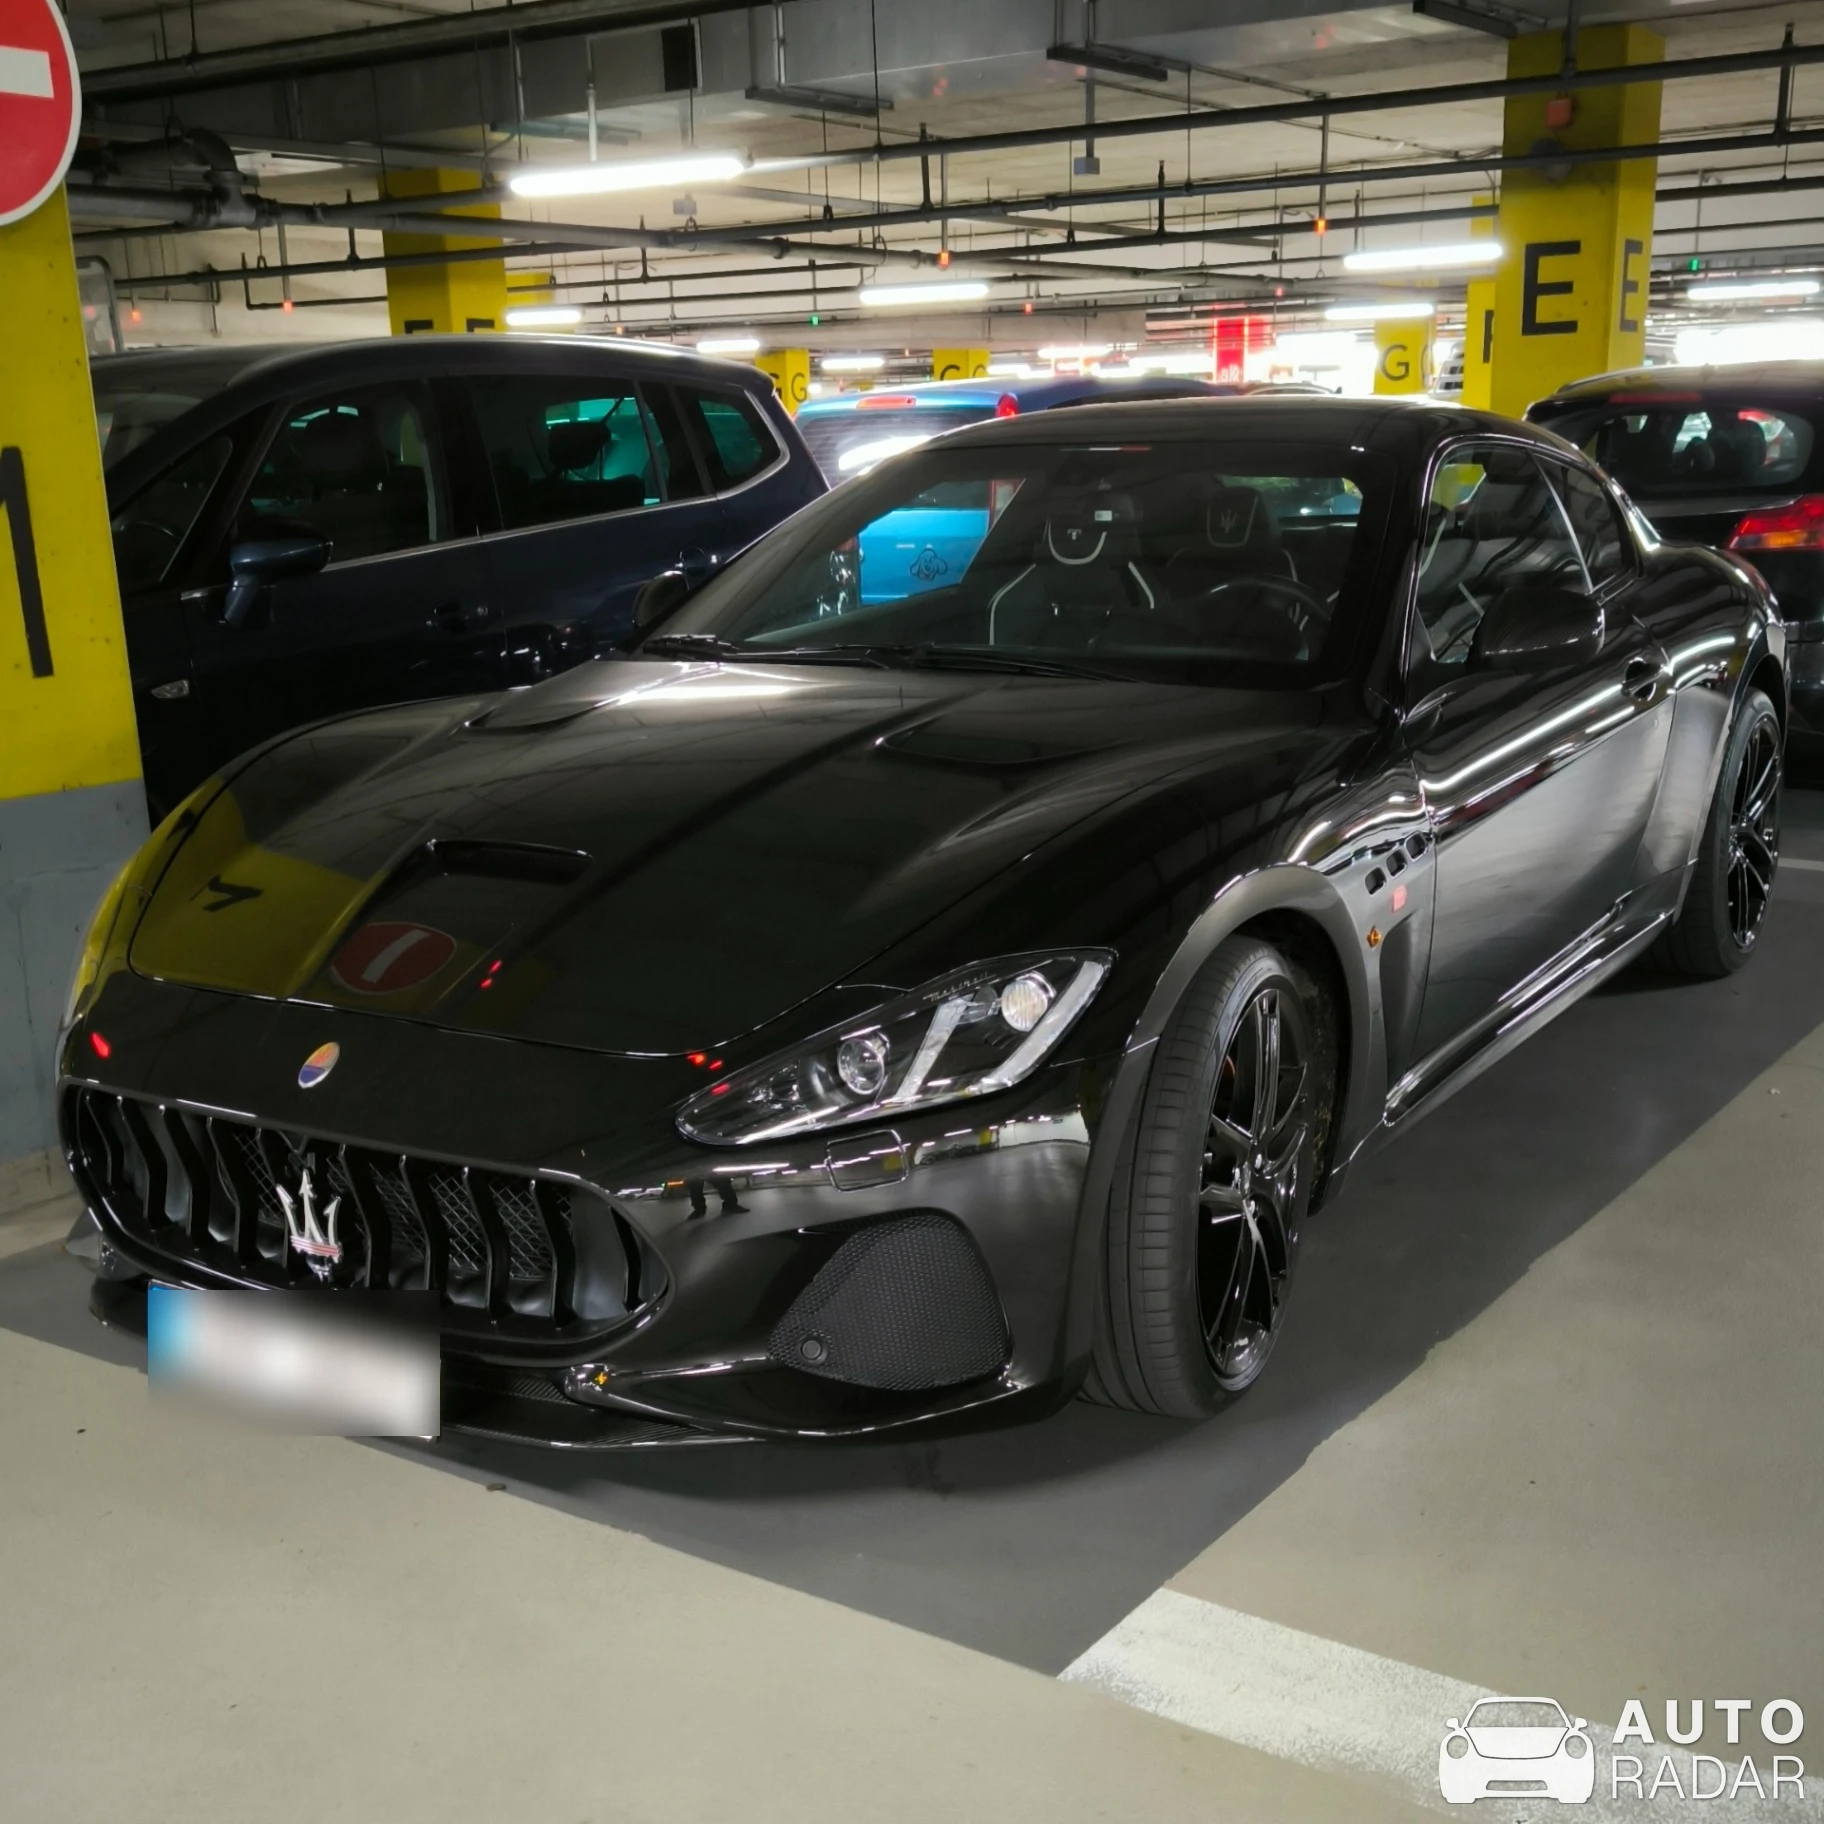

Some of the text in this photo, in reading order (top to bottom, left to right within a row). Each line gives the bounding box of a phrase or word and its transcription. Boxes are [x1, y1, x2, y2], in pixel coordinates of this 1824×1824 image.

[1521, 240, 1581, 336] E
[1619, 238, 1643, 332] E
[791, 371, 807, 403] G
[1382, 344, 1410, 382] G
